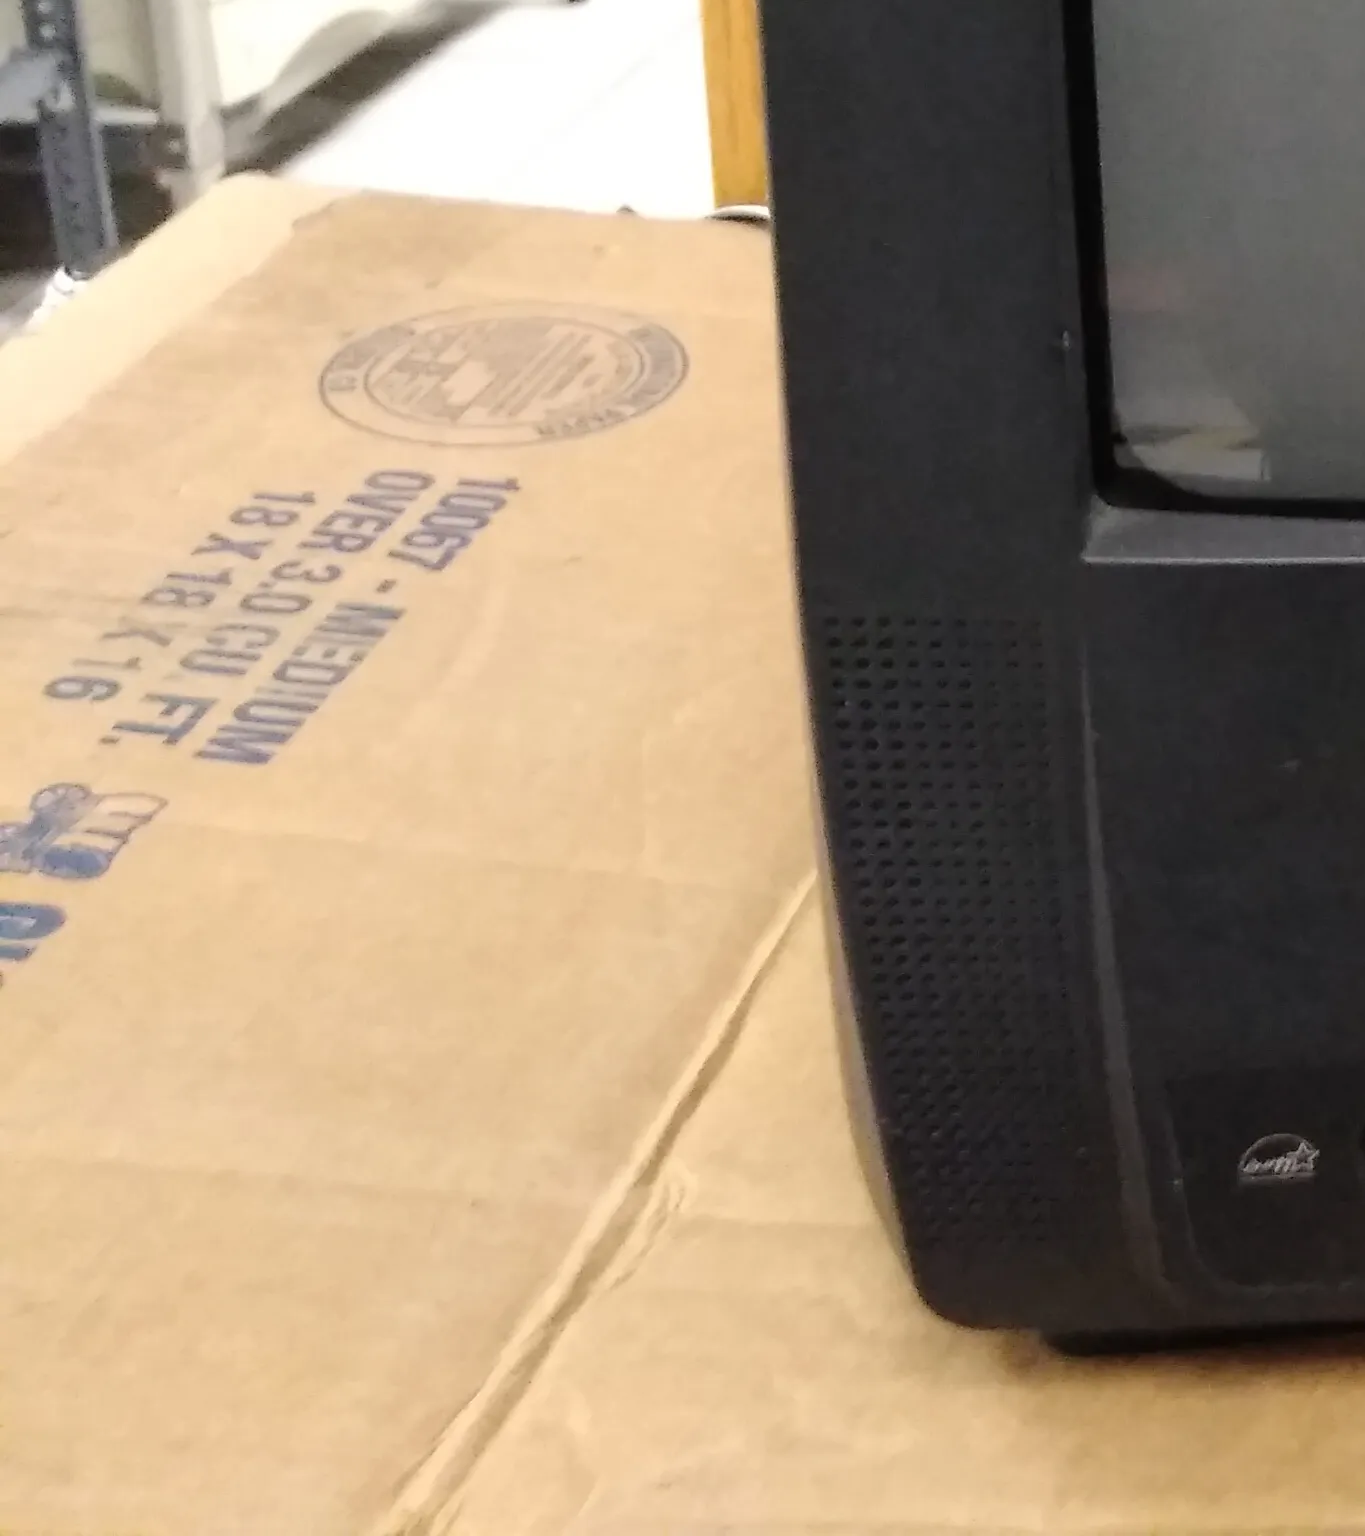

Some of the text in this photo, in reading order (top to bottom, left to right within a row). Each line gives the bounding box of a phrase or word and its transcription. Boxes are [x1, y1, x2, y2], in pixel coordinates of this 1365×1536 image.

[229, 491, 316, 527] 18
[297, 469, 436, 553] OVER
[387, 476, 520, 572] 10067
[192, 532, 273, 560] X
[141, 567, 233, 607] 18
[239, 560, 344, 614] 3.0
[101, 617, 187, 648] X
[180, 622, 281, 676] CU
[193, 601, 406, 765] MEDIUM
